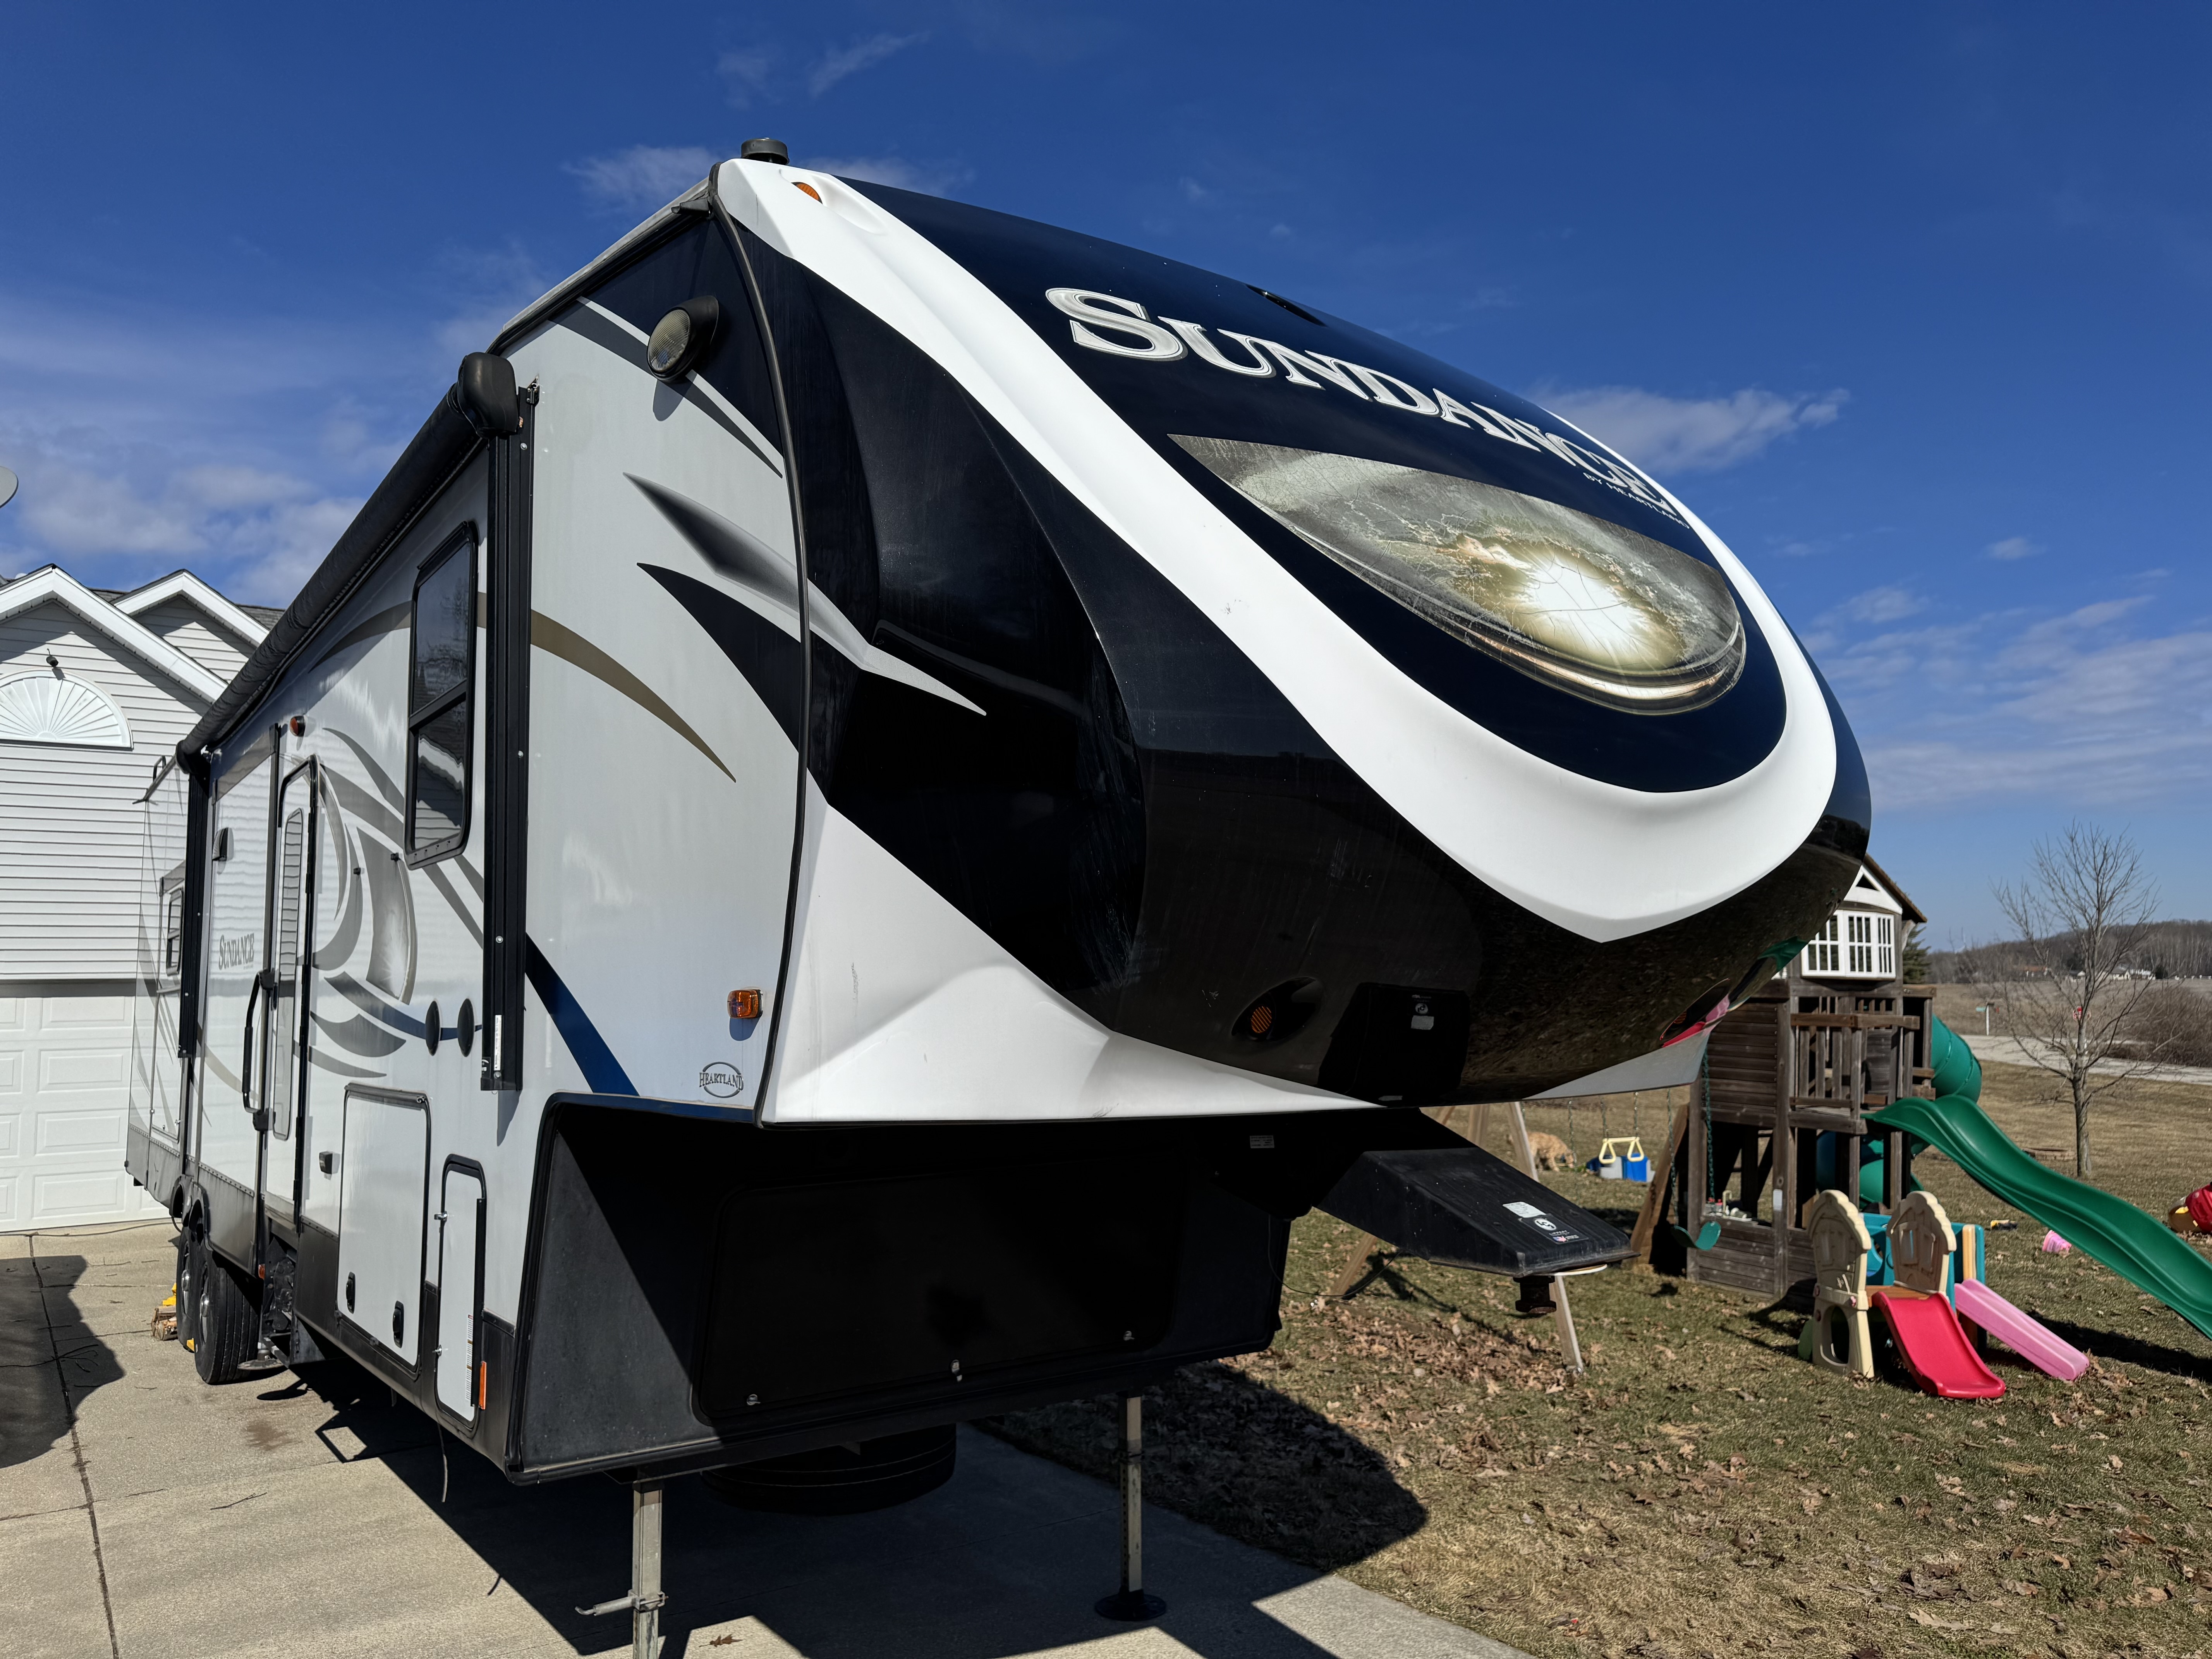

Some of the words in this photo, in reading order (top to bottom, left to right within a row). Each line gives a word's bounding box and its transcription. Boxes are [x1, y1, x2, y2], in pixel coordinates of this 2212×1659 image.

[1045, 287, 1677, 516] SUNDANCE
[1583, 472, 1602, 484] BY
[219, 933, 254, 970] SUNDANCE
[699, 1072, 744, 1091] HEARTLAND
